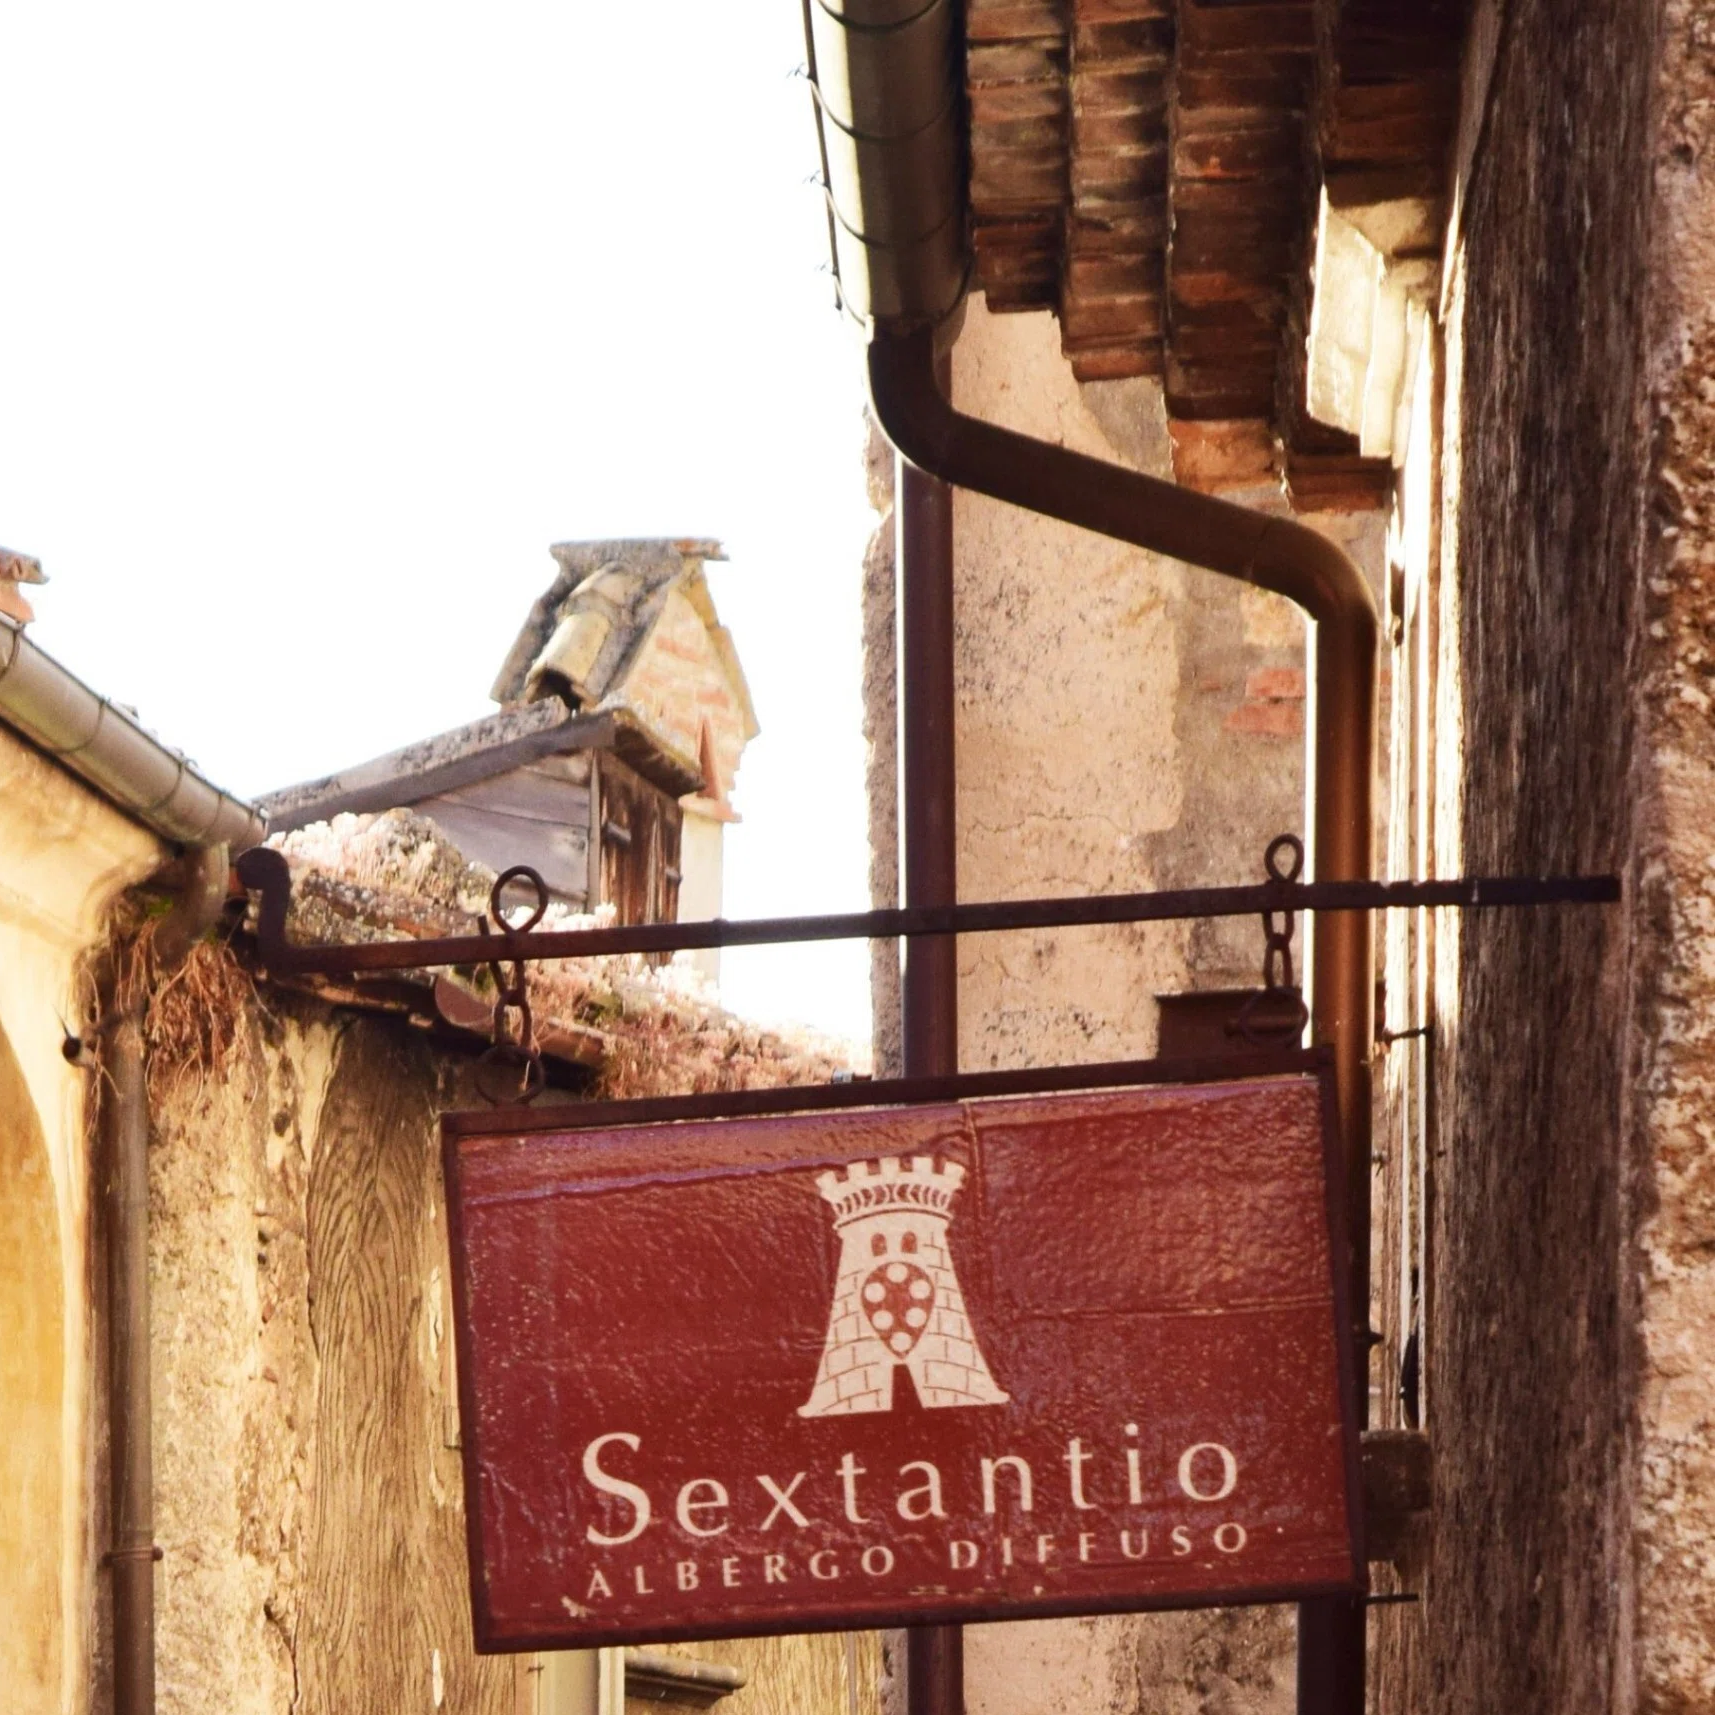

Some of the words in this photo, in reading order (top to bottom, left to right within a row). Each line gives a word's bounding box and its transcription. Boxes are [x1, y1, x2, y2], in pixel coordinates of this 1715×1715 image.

[583, 1422, 1237, 1546] Sextantio
[587, 1546, 894, 1598] ALBERGO
[950, 1523, 1247, 1569] DIFFUSO
